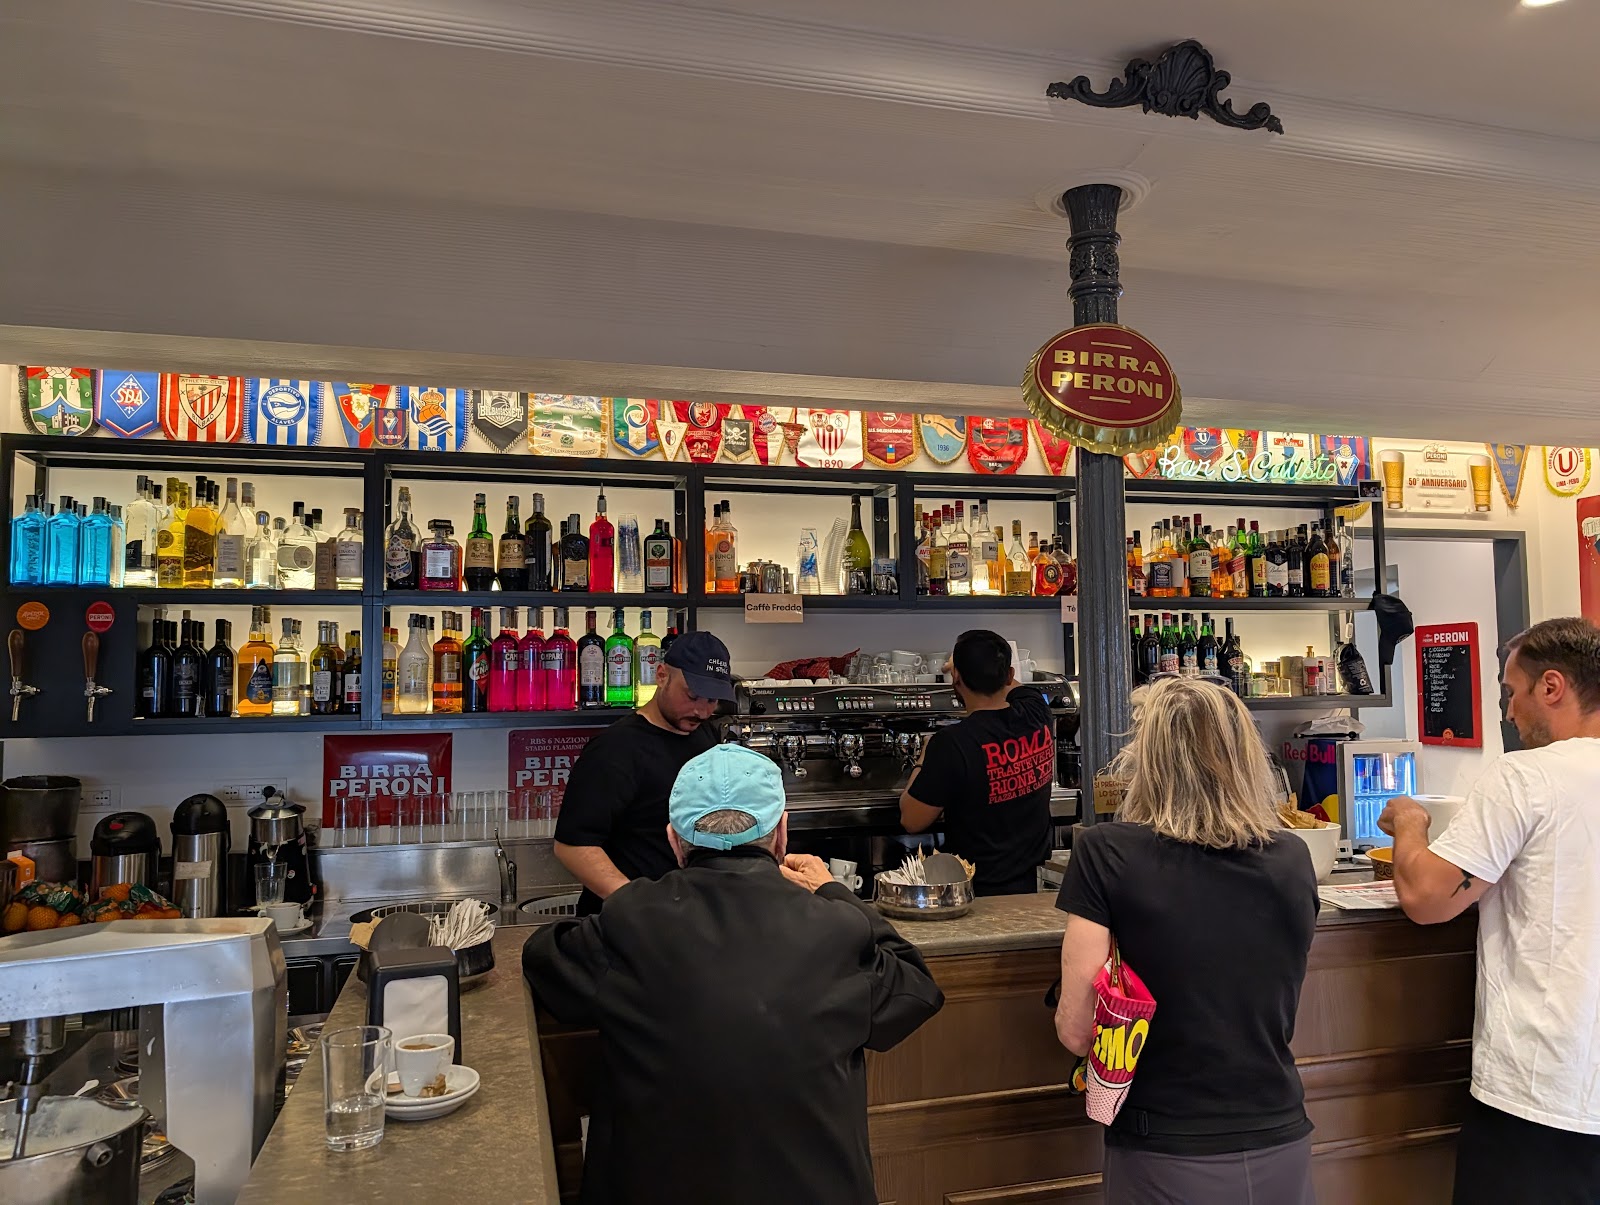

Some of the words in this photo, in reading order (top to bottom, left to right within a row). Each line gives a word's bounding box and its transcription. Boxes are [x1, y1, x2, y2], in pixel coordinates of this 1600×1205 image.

[1054, 349, 1162, 377] BIRRA
[267, 387, 300, 398] DEPORTIVO
[1051, 370, 1164, 400] PERONI
[116, 388, 143, 406] SDA
[191, 413, 215, 428] BILBAO
[937, 444, 949, 452] 1936
[818, 459, 844, 468] 1890
[1158, 445, 1215, 479] Bar
[1249, 451, 1339, 482] Calisto
[1426, 452, 1448, 460] PERONI
[1558, 450, 1573, 473] U
[1421, 478, 1467, 488] ANNIVERSARIO
[746, 603, 771, 611] Caffè
[772, 603, 802, 611] Freddo
[1066, 605, 1076, 613] Tè
[1434, 631, 1469, 643] PERONI
[981, 724, 1054, 769] ROMA
[1283, 742, 1308, 760] Red
[1309, 743, 1335, 764] Bull
[525, 755, 580, 770] BIR
[340, 763, 433, 778] BIRRA
[329, 777, 445, 797] PERONI
[989, 769, 1037, 797] RIONE
[988, 792, 1018, 805] PIAZZA
[1018, 789, 1026, 797] DI
